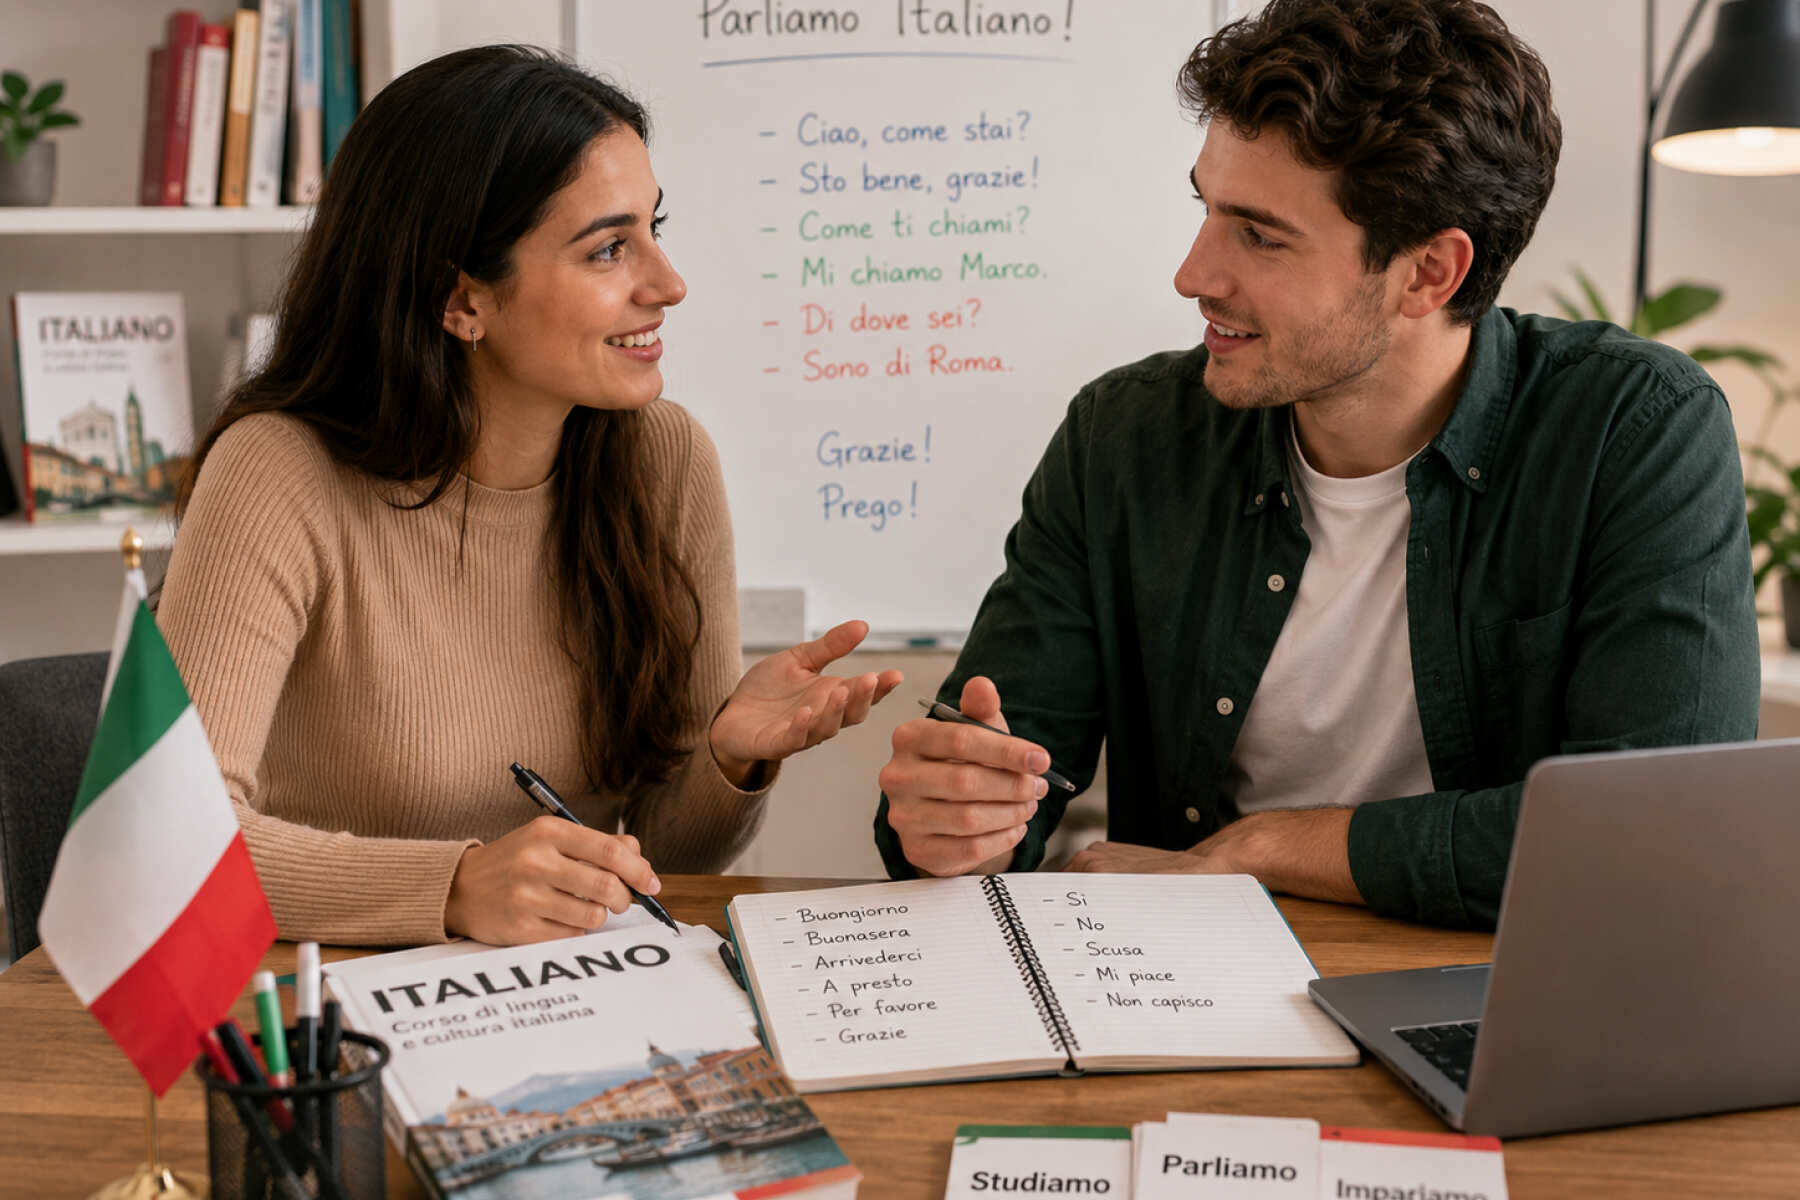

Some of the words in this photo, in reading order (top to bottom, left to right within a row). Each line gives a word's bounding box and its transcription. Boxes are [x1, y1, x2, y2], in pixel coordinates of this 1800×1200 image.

[797, 111, 868, 149] Ciao,
[881, 125, 947, 143] come
[964, 110, 1031, 142] stai?
[799, 161, 847, 195] Sto
[862, 163, 932, 194] bene,
[946, 157, 1039, 203] grazie!
[798, 210, 873, 242] Come
[890, 209, 913, 239] ti
[928, 205, 1030, 237] chiami?
[801, 256, 834, 287] Mi
[850, 255, 943, 286] chiamo
[959, 251, 1048, 281] Marco.
[38, 315, 175, 344] ITALIANO
[799, 303, 833, 336] Di
[849, 303, 910, 333] dove
[927, 297, 982, 330] sei?
[802, 348, 870, 382] Sono
[885, 347, 910, 377] di
[927, 343, 1014, 375] Roma.
[817, 425, 931, 468] Grazie!
[818, 480, 918, 532] Prego!
[796, 905, 909, 924] Buongiorno
[1076, 916, 1105, 931] No
[804, 928, 911, 946] Buonasera
[1085, 940, 1145, 957] Scusa
[815, 949, 922, 970] Arrivederci
[371, 944, 671, 1014] ITALIANO
[823, 978, 839, 994] A
[850, 973, 913, 998] presto
[1095, 966, 1120, 981] Mi
[1128, 972, 1176, 987] piace
[391, 1014, 468, 1035] Corso
[475, 1004, 499, 1020] di
[505, 992, 581, 1014] lingua
[826, 1003, 862, 1019] Per
[874, 999, 937, 1016] favore
[1106, 991, 1143, 1007] Non
[1151, 998, 1214, 1013] capisco
[402, 1038, 416, 1051] e
[422, 1022, 505, 1047] cultura
[511, 1005, 596, 1030] italiana
[838, 1028, 907, 1044] Grazie
[1162, 1154, 1297, 1181] Parliamo
[970, 1171, 1111, 1194] Studiamo
